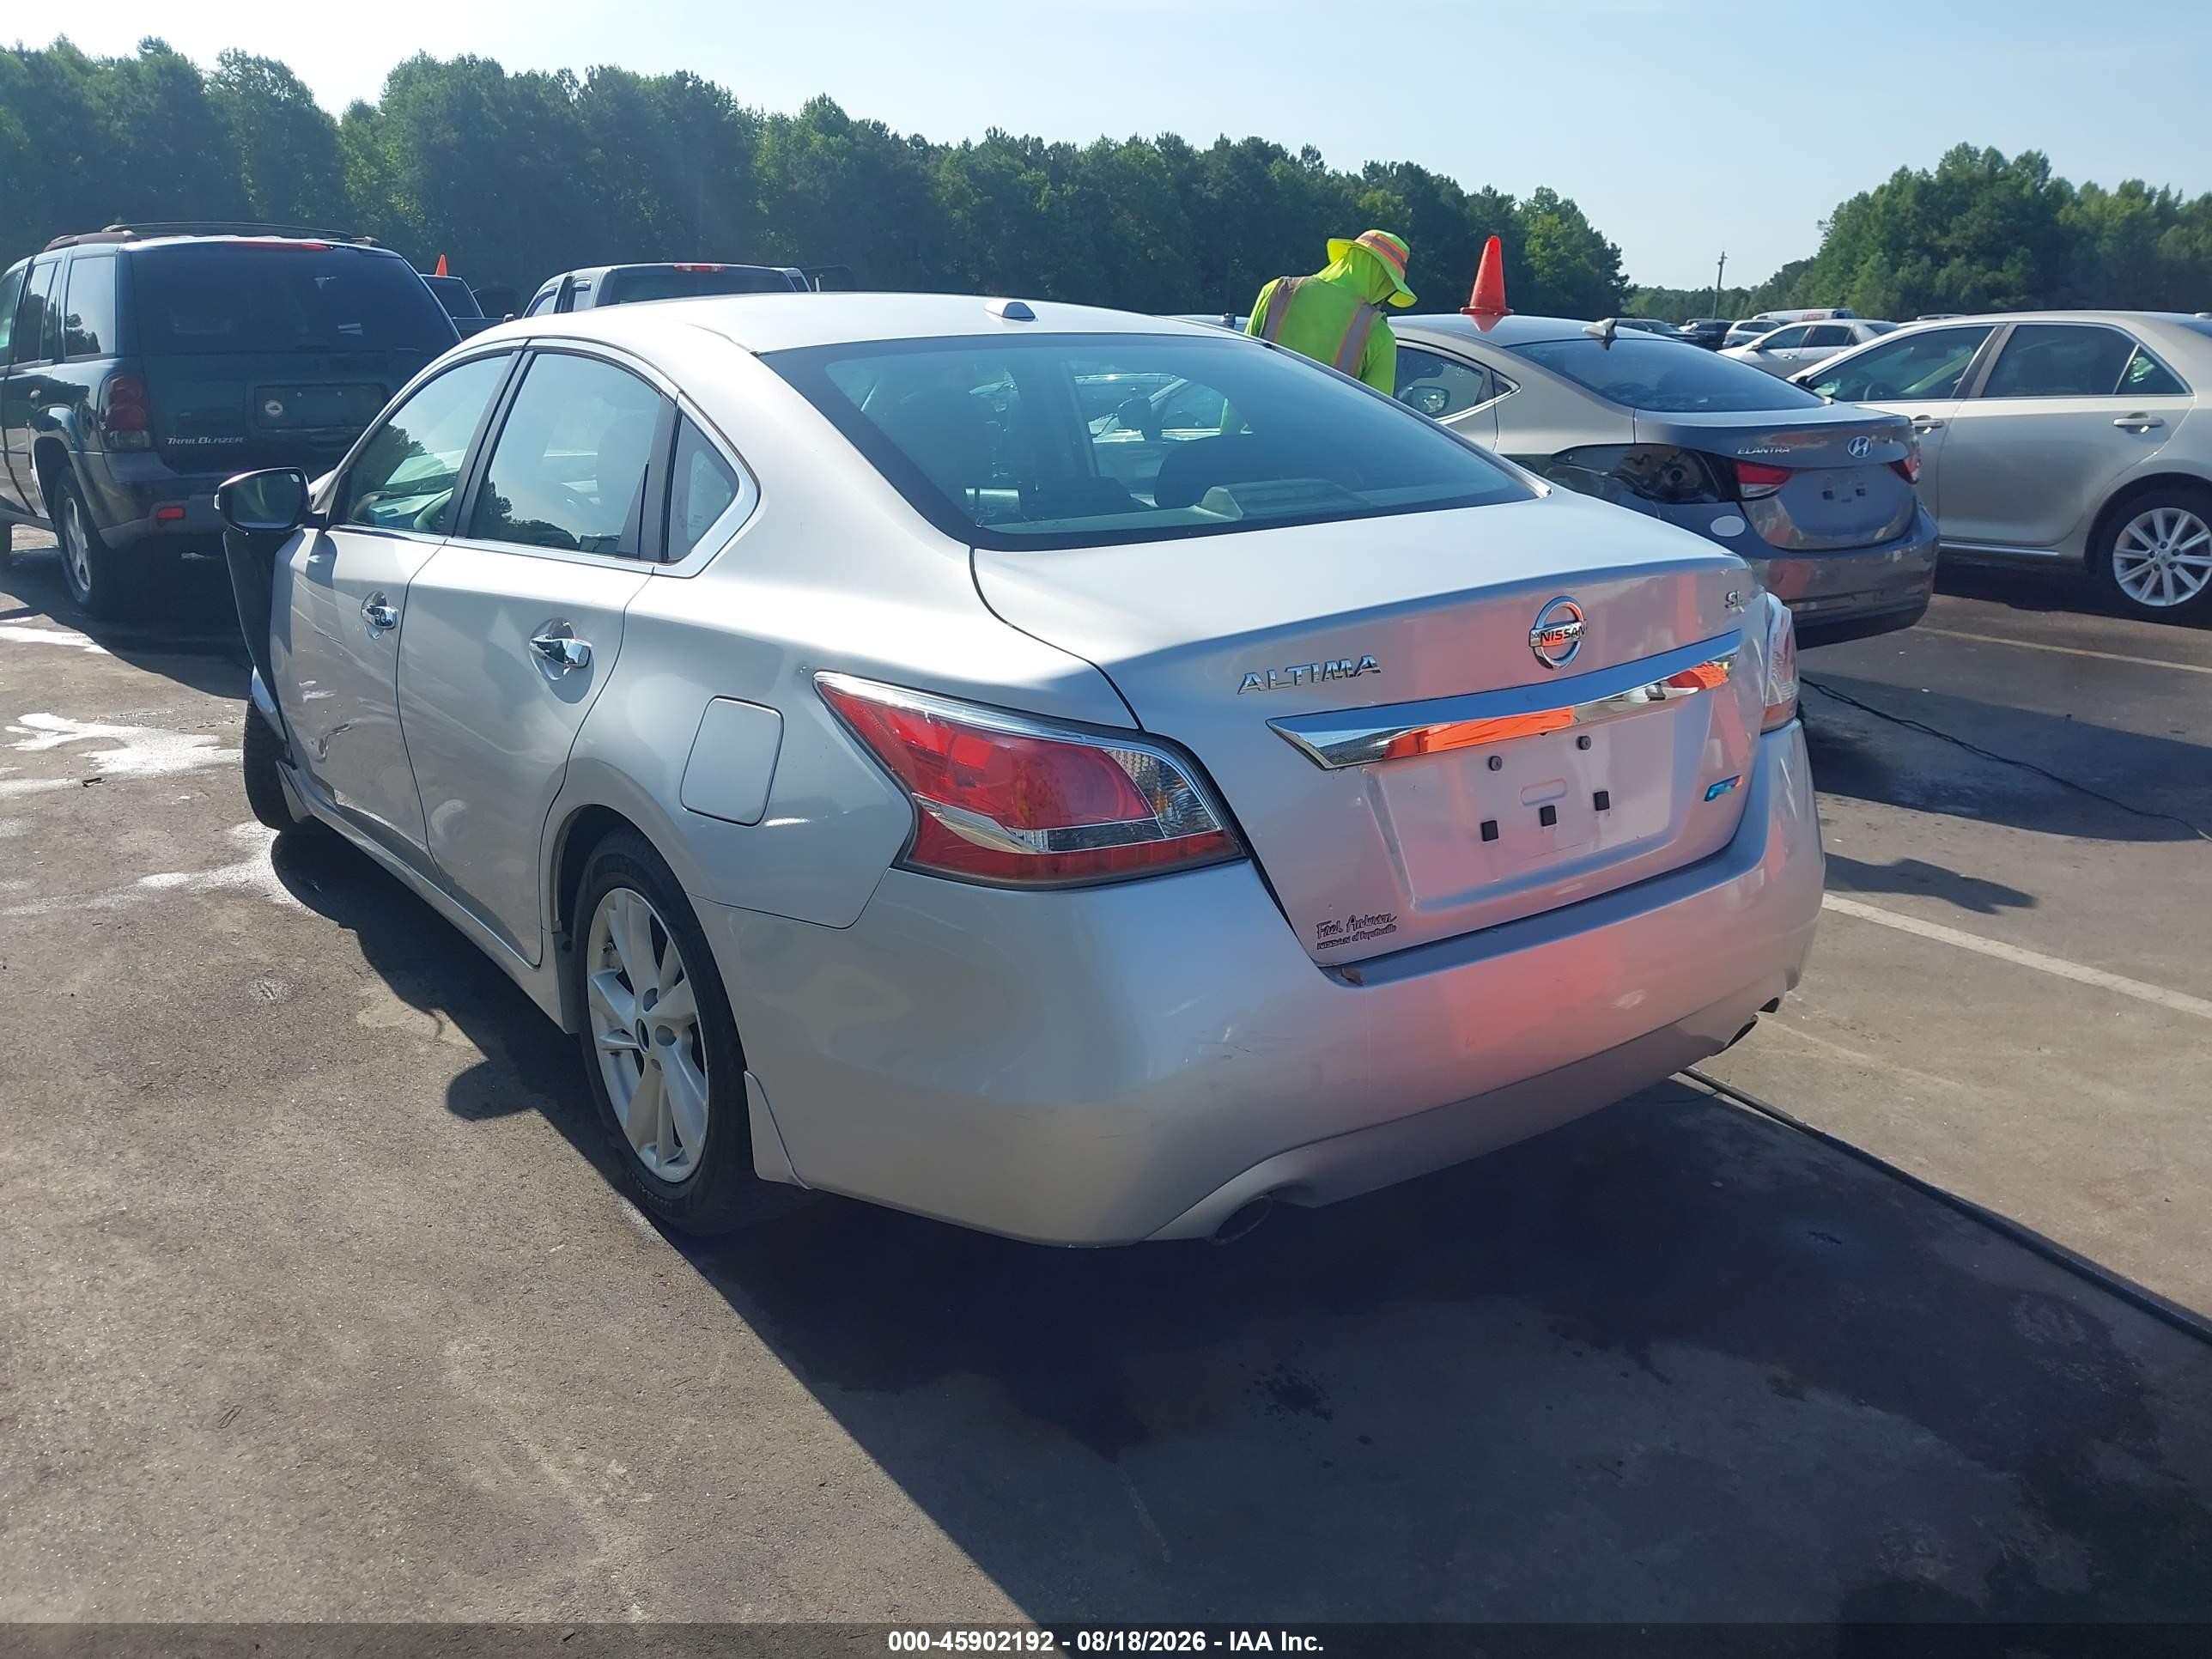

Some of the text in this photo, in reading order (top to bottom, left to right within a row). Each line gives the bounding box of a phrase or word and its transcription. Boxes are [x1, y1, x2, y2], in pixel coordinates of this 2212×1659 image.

[1737, 446, 1791, 455] ELANTRA
[1540, 626, 1586, 642] NISSAN
[1237, 654, 1382, 695] ALTIMA
